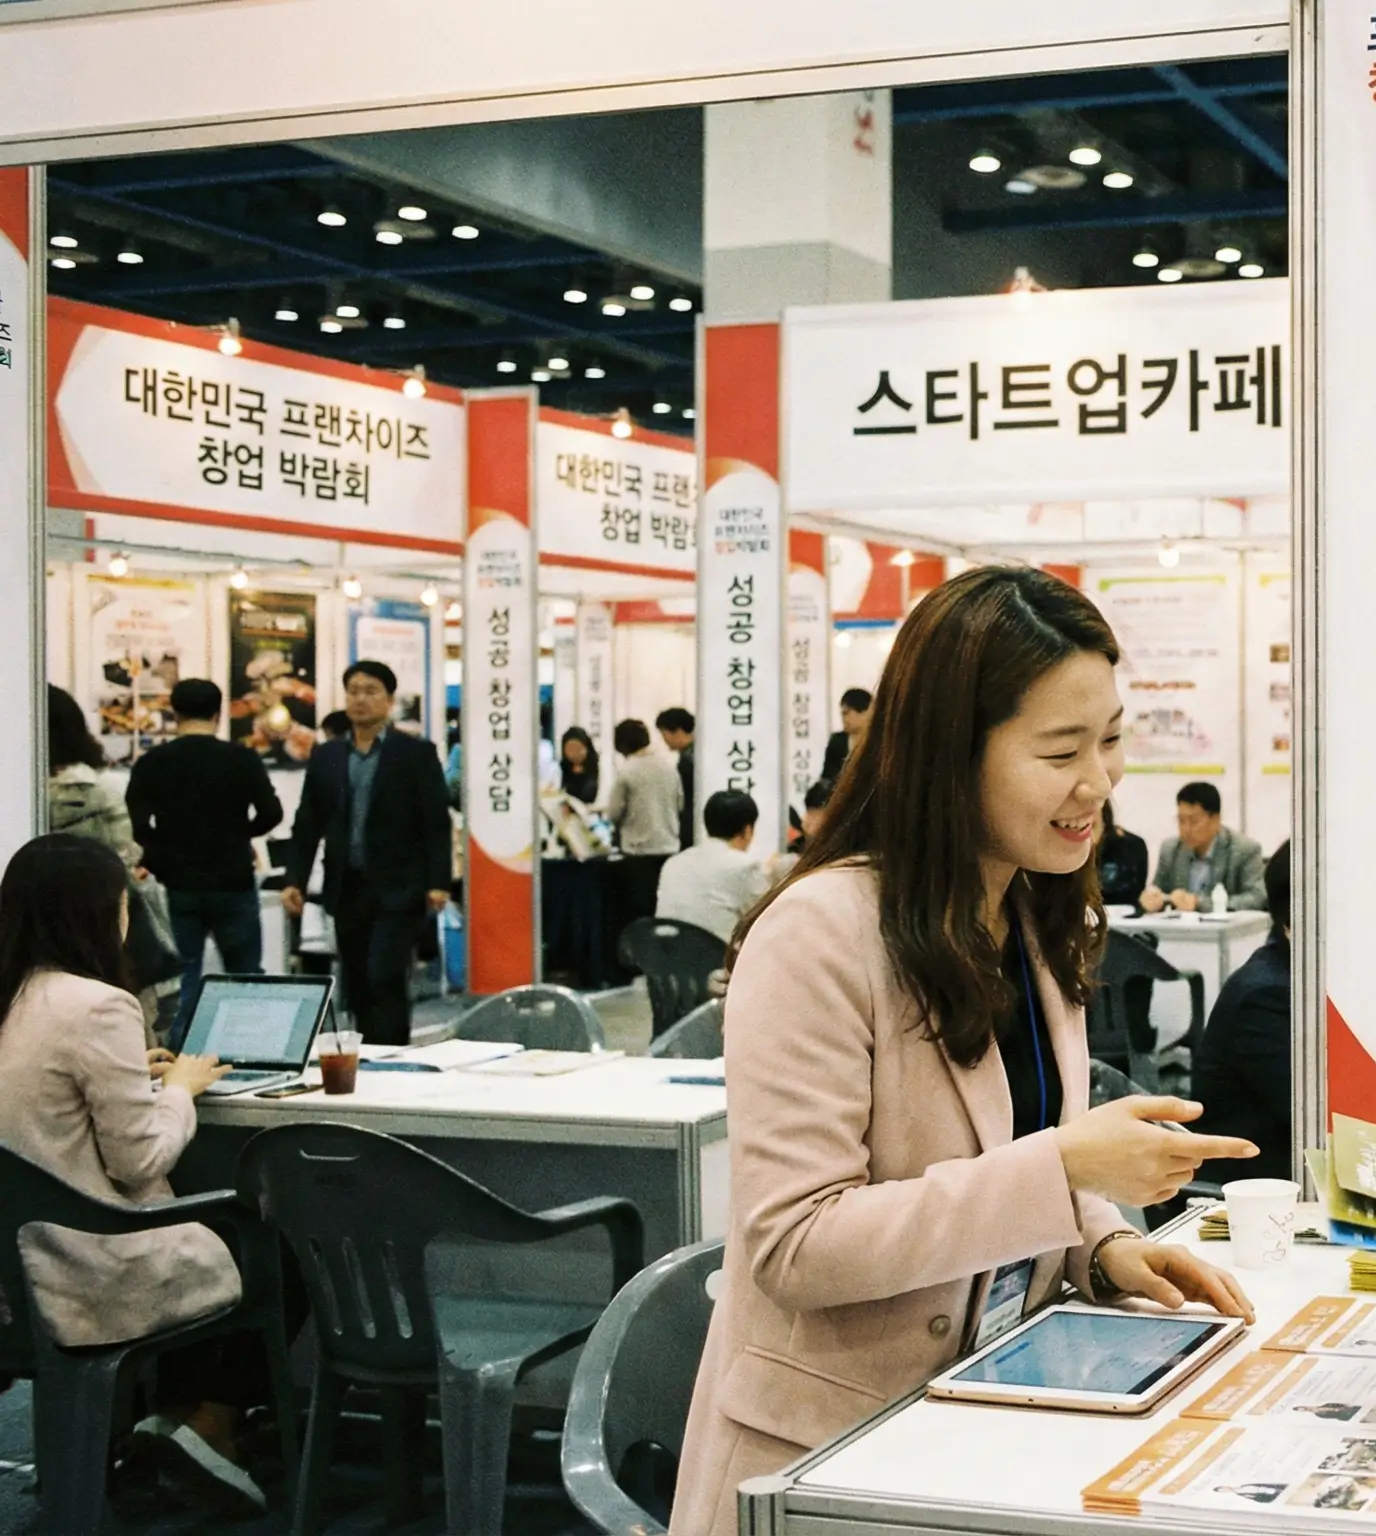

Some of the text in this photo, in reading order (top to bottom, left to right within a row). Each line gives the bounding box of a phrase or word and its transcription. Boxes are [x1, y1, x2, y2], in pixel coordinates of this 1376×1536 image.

[124, 366, 431, 460] 대한민국 프랜차이즈
[853, 344, 1282, 441] 스타트업카페
[198, 435, 371, 505] 창업 박람회
[556, 454, 697, 509] 대한민국 프랜
[600, 503, 642, 546] 창업
[488, 607, 510, 669] 성공
[726, 574, 755, 644] 성공
[488, 677, 512, 741] 창업
[727, 656, 756, 726] 창업
[488, 753, 513, 813] 상담
